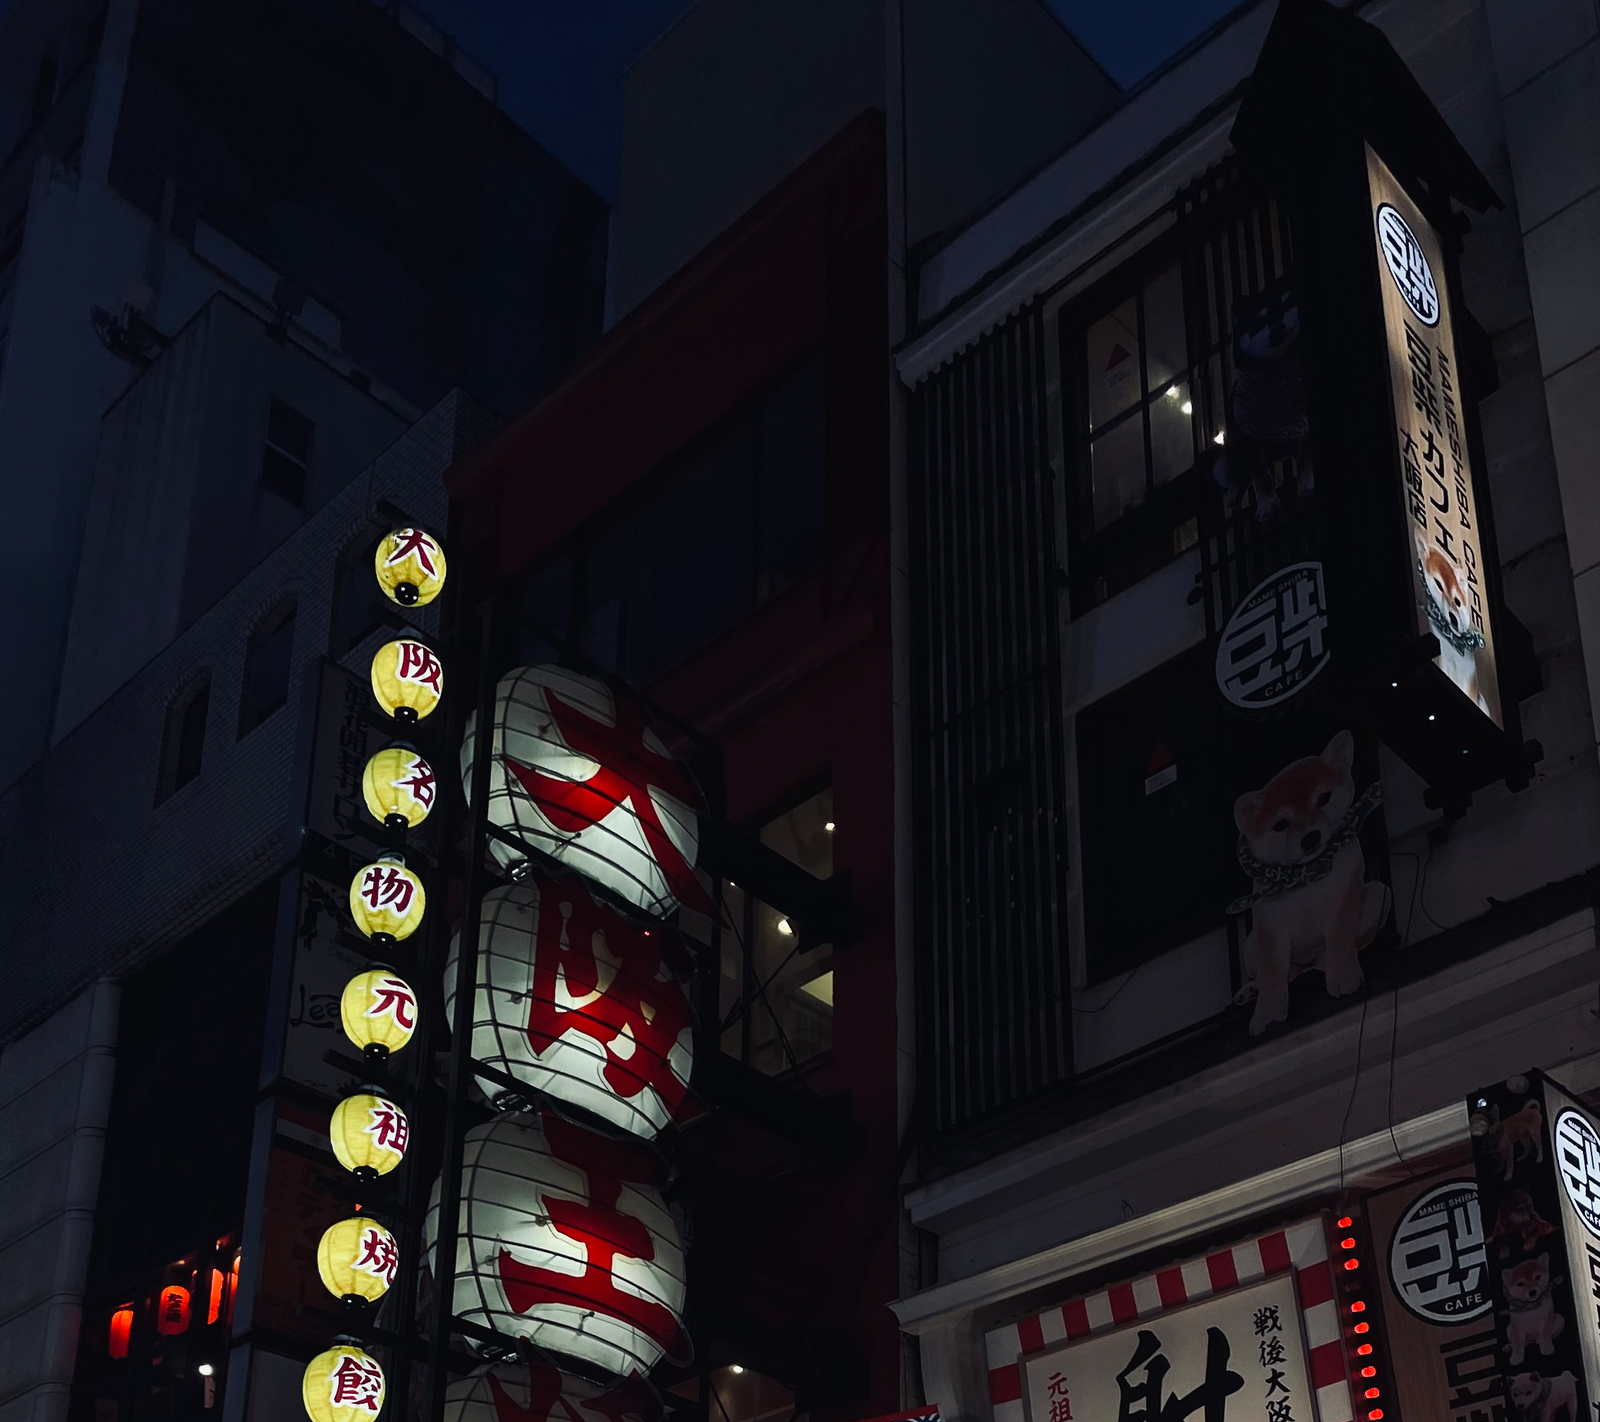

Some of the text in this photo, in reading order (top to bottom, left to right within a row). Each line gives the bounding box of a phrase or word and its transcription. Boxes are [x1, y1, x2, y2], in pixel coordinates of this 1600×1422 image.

[1436, 346, 1485, 635] MAMESHIBA CAFE
[1248, 570, 1309, 609] MAME SHIBA
[1264, 669, 1303, 697] CAFE
[1419, 1191, 1479, 1217] MAME SHIBA
[1444, 1293, 1483, 1312] CAFE
